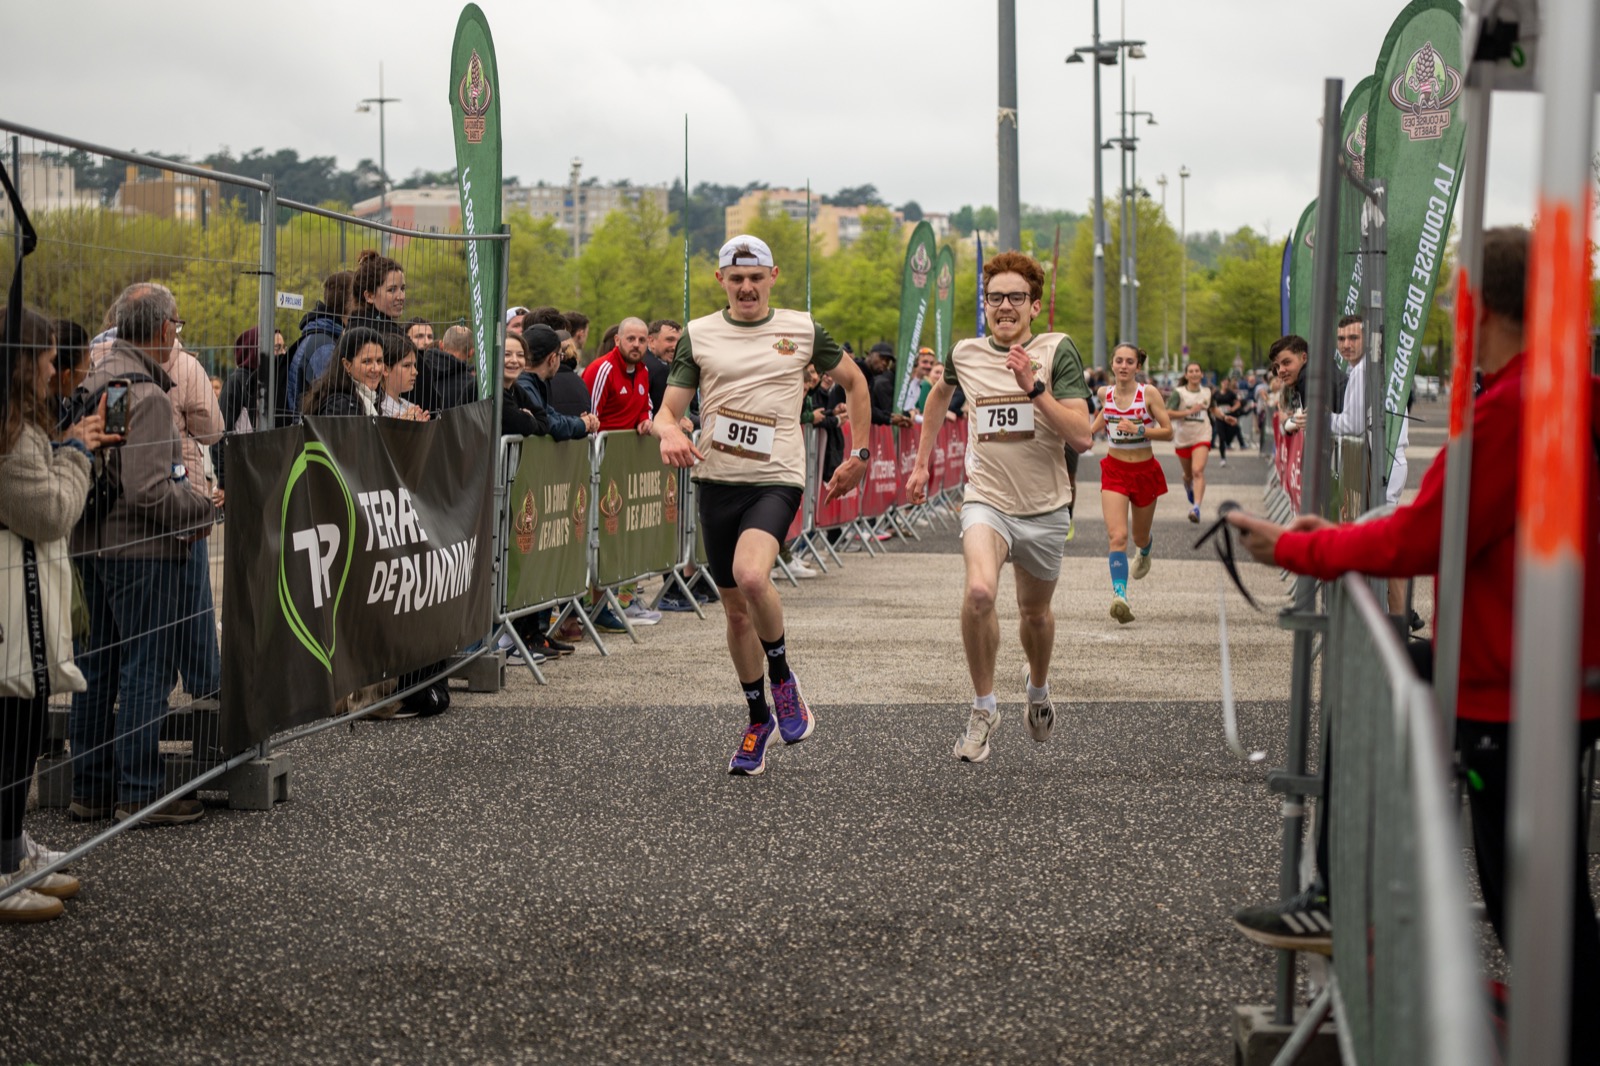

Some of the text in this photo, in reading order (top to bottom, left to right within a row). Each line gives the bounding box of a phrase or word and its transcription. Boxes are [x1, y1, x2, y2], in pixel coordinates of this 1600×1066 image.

[462, 166, 471, 200] LA
[473, 281, 483, 326] DES
[987, 407, 1018, 428] 759
[727, 422, 759, 446] 915
[628, 470, 661, 499] LA COURSE
[626, 504, 640, 532] DES
[30, 605, 41, 649] JIMMY
[35, 653, 48, 695] FAIRL
